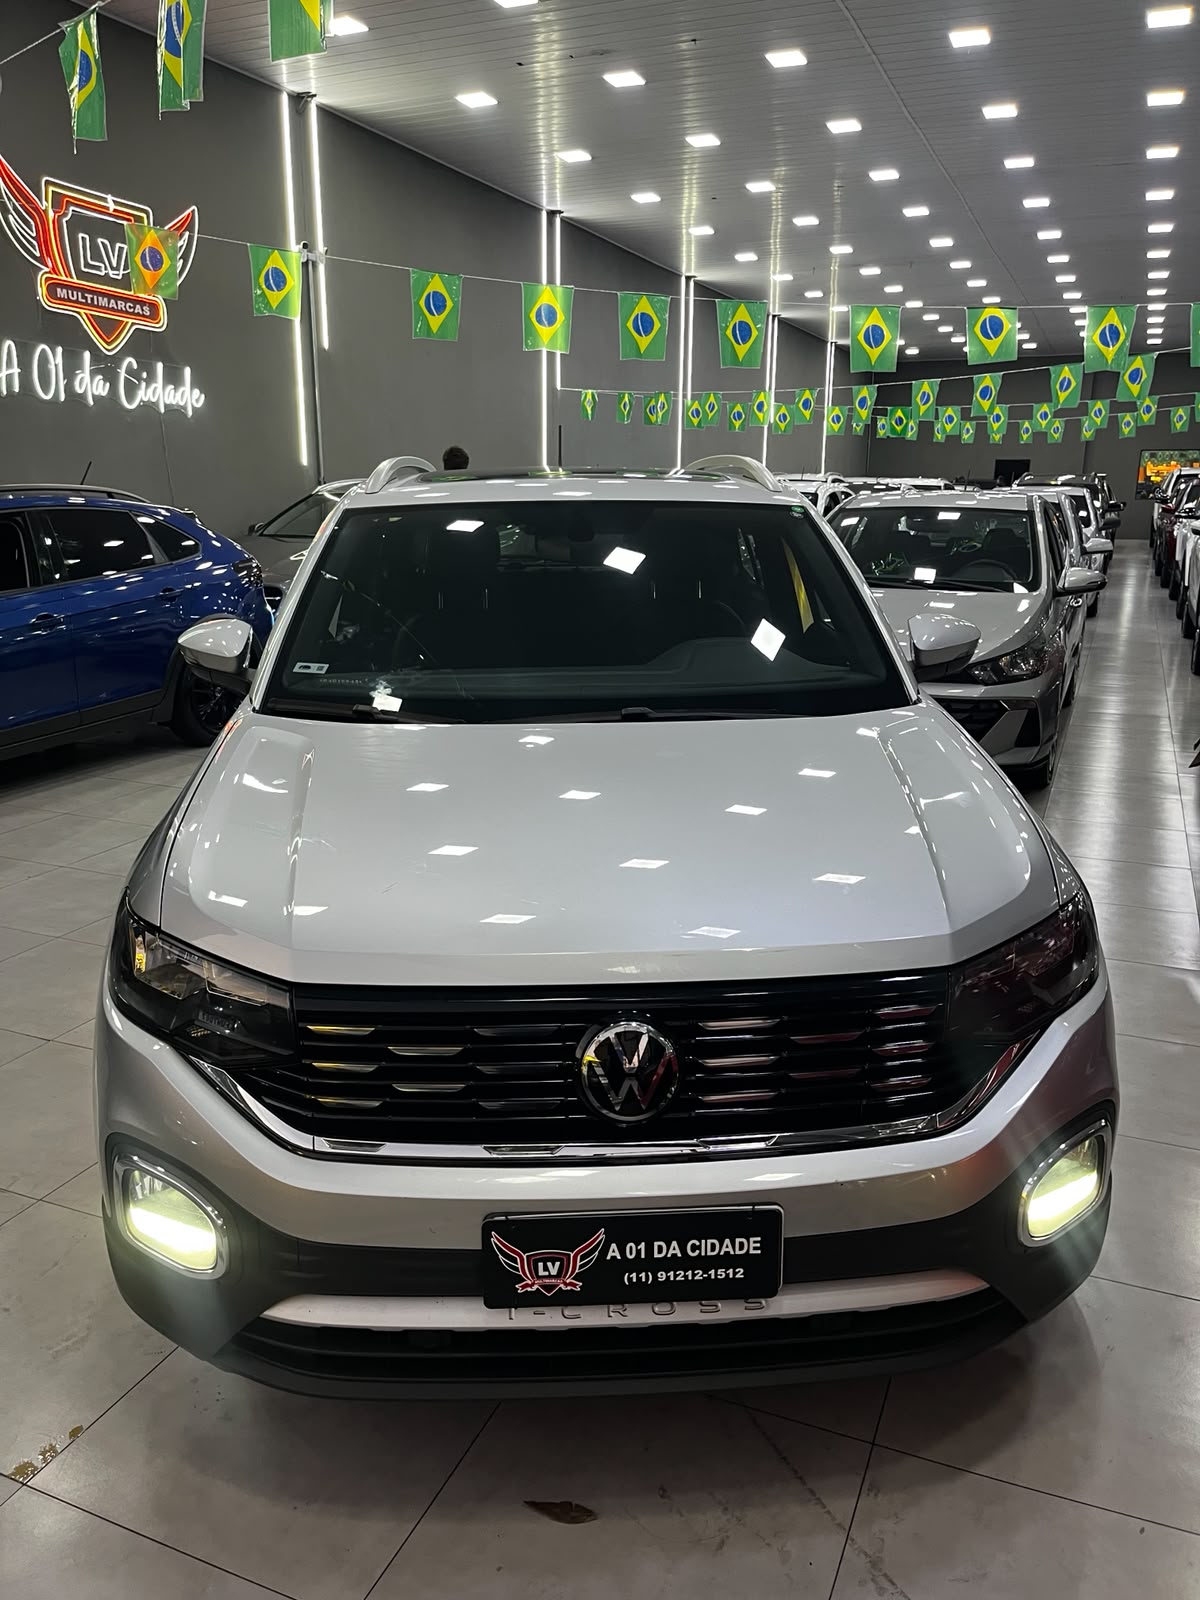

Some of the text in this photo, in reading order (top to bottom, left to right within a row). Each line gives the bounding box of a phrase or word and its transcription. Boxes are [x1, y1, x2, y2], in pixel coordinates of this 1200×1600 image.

[78, 232, 128, 280] LV
[56, 287, 150, 316] MULTIMARCAS
[0, 339, 21, 397] A
[74, 350, 111, 407] da
[118, 356, 206, 418] Cidade
[606, 1237, 761, 1260] A 01 DA CIDADE
[537, 1261, 561, 1276] LV
[624, 1268, 745, 1285] (11) 91212-1512
